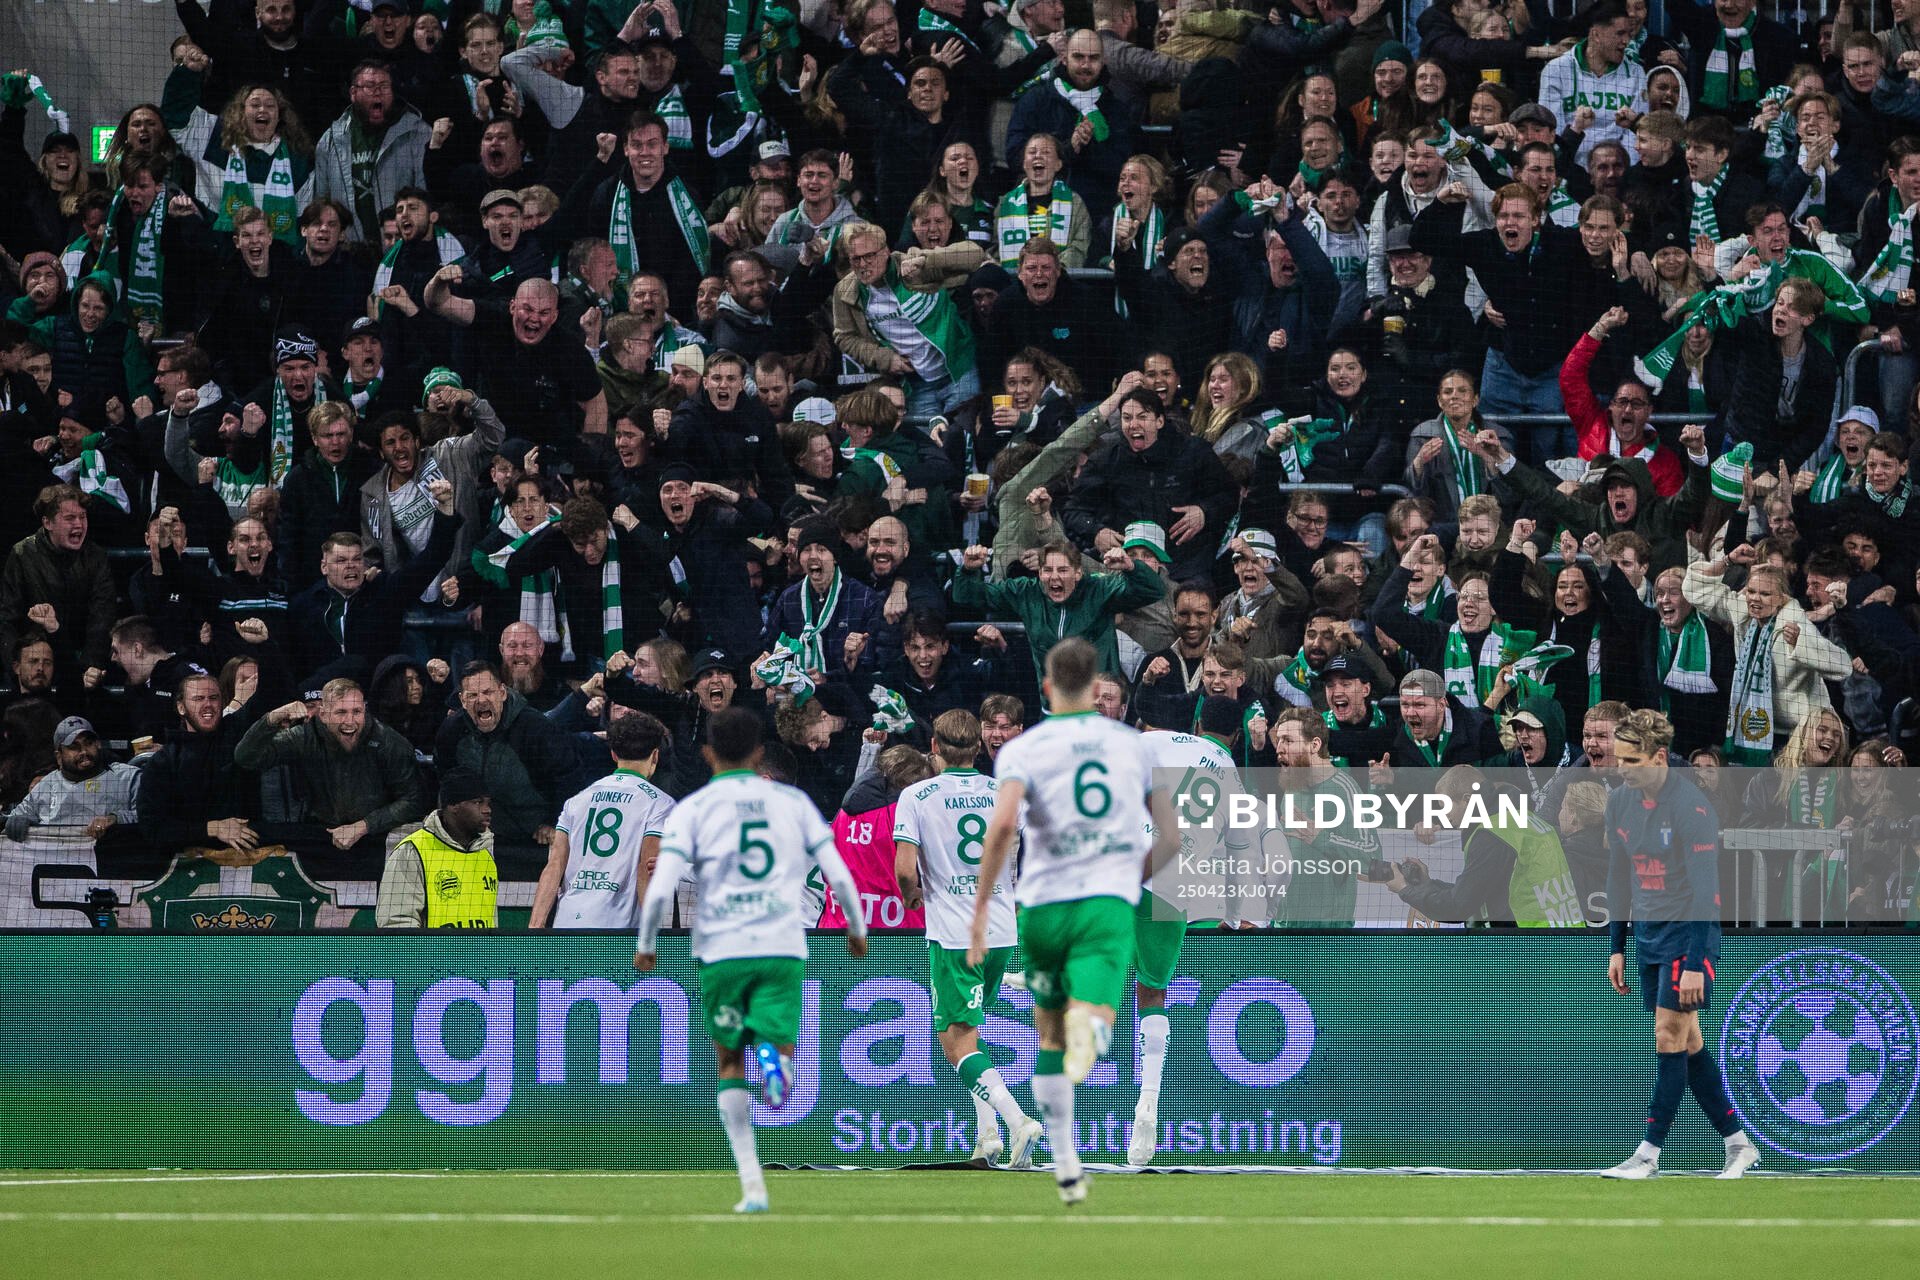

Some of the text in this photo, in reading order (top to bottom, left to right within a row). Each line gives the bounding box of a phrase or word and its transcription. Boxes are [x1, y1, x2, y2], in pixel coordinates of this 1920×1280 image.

[1074, 760, 1113, 819] 6
[1198, 756, 1226, 781] PINAS
[591, 791, 633, 804] TOUNEKTI
[944, 797, 995, 810] KARLSSON
[1171, 765, 1222, 825] 19
[583, 807, 623, 858] 18
[738, 820, 775, 880] 5
[846, 820, 873, 846] 18
[957, 813, 987, 866] 8
[292, 977, 690, 1127] ggm
